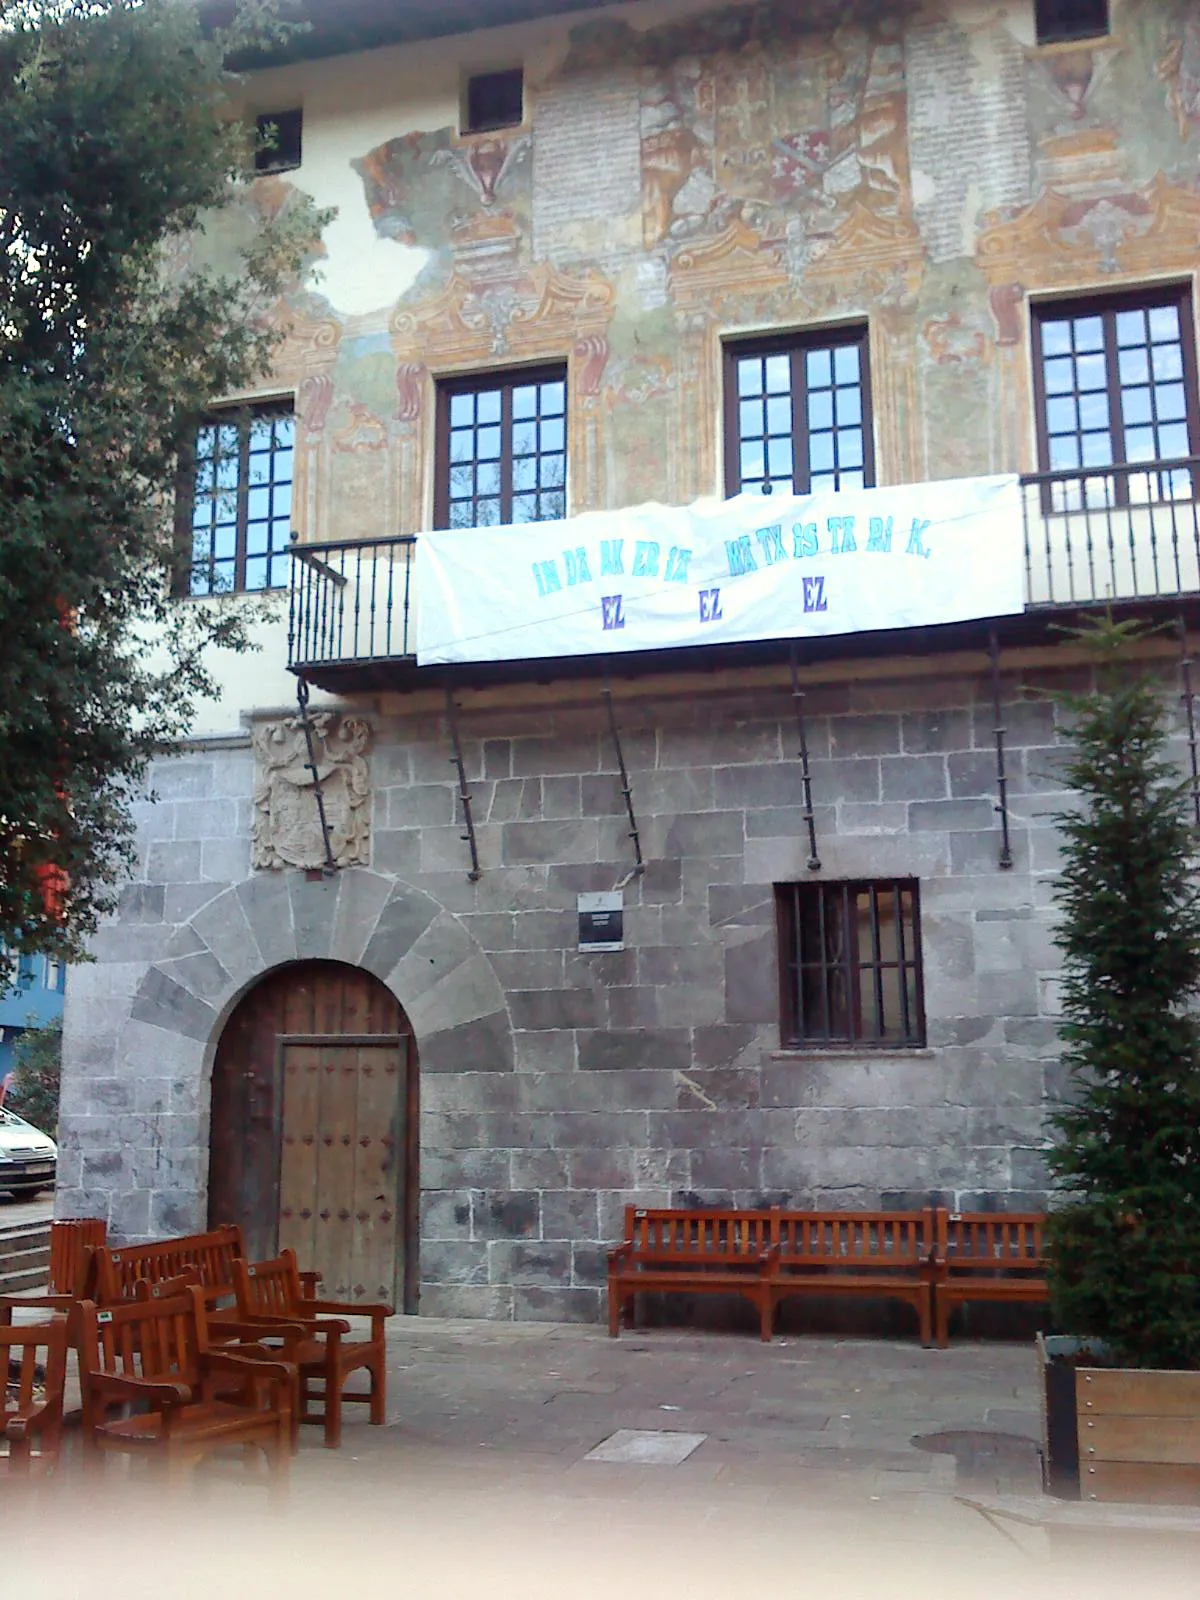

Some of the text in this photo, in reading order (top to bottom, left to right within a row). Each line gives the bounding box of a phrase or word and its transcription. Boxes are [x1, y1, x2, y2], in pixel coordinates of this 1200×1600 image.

[601, 576, 828, 631] EZ EZ EZ
